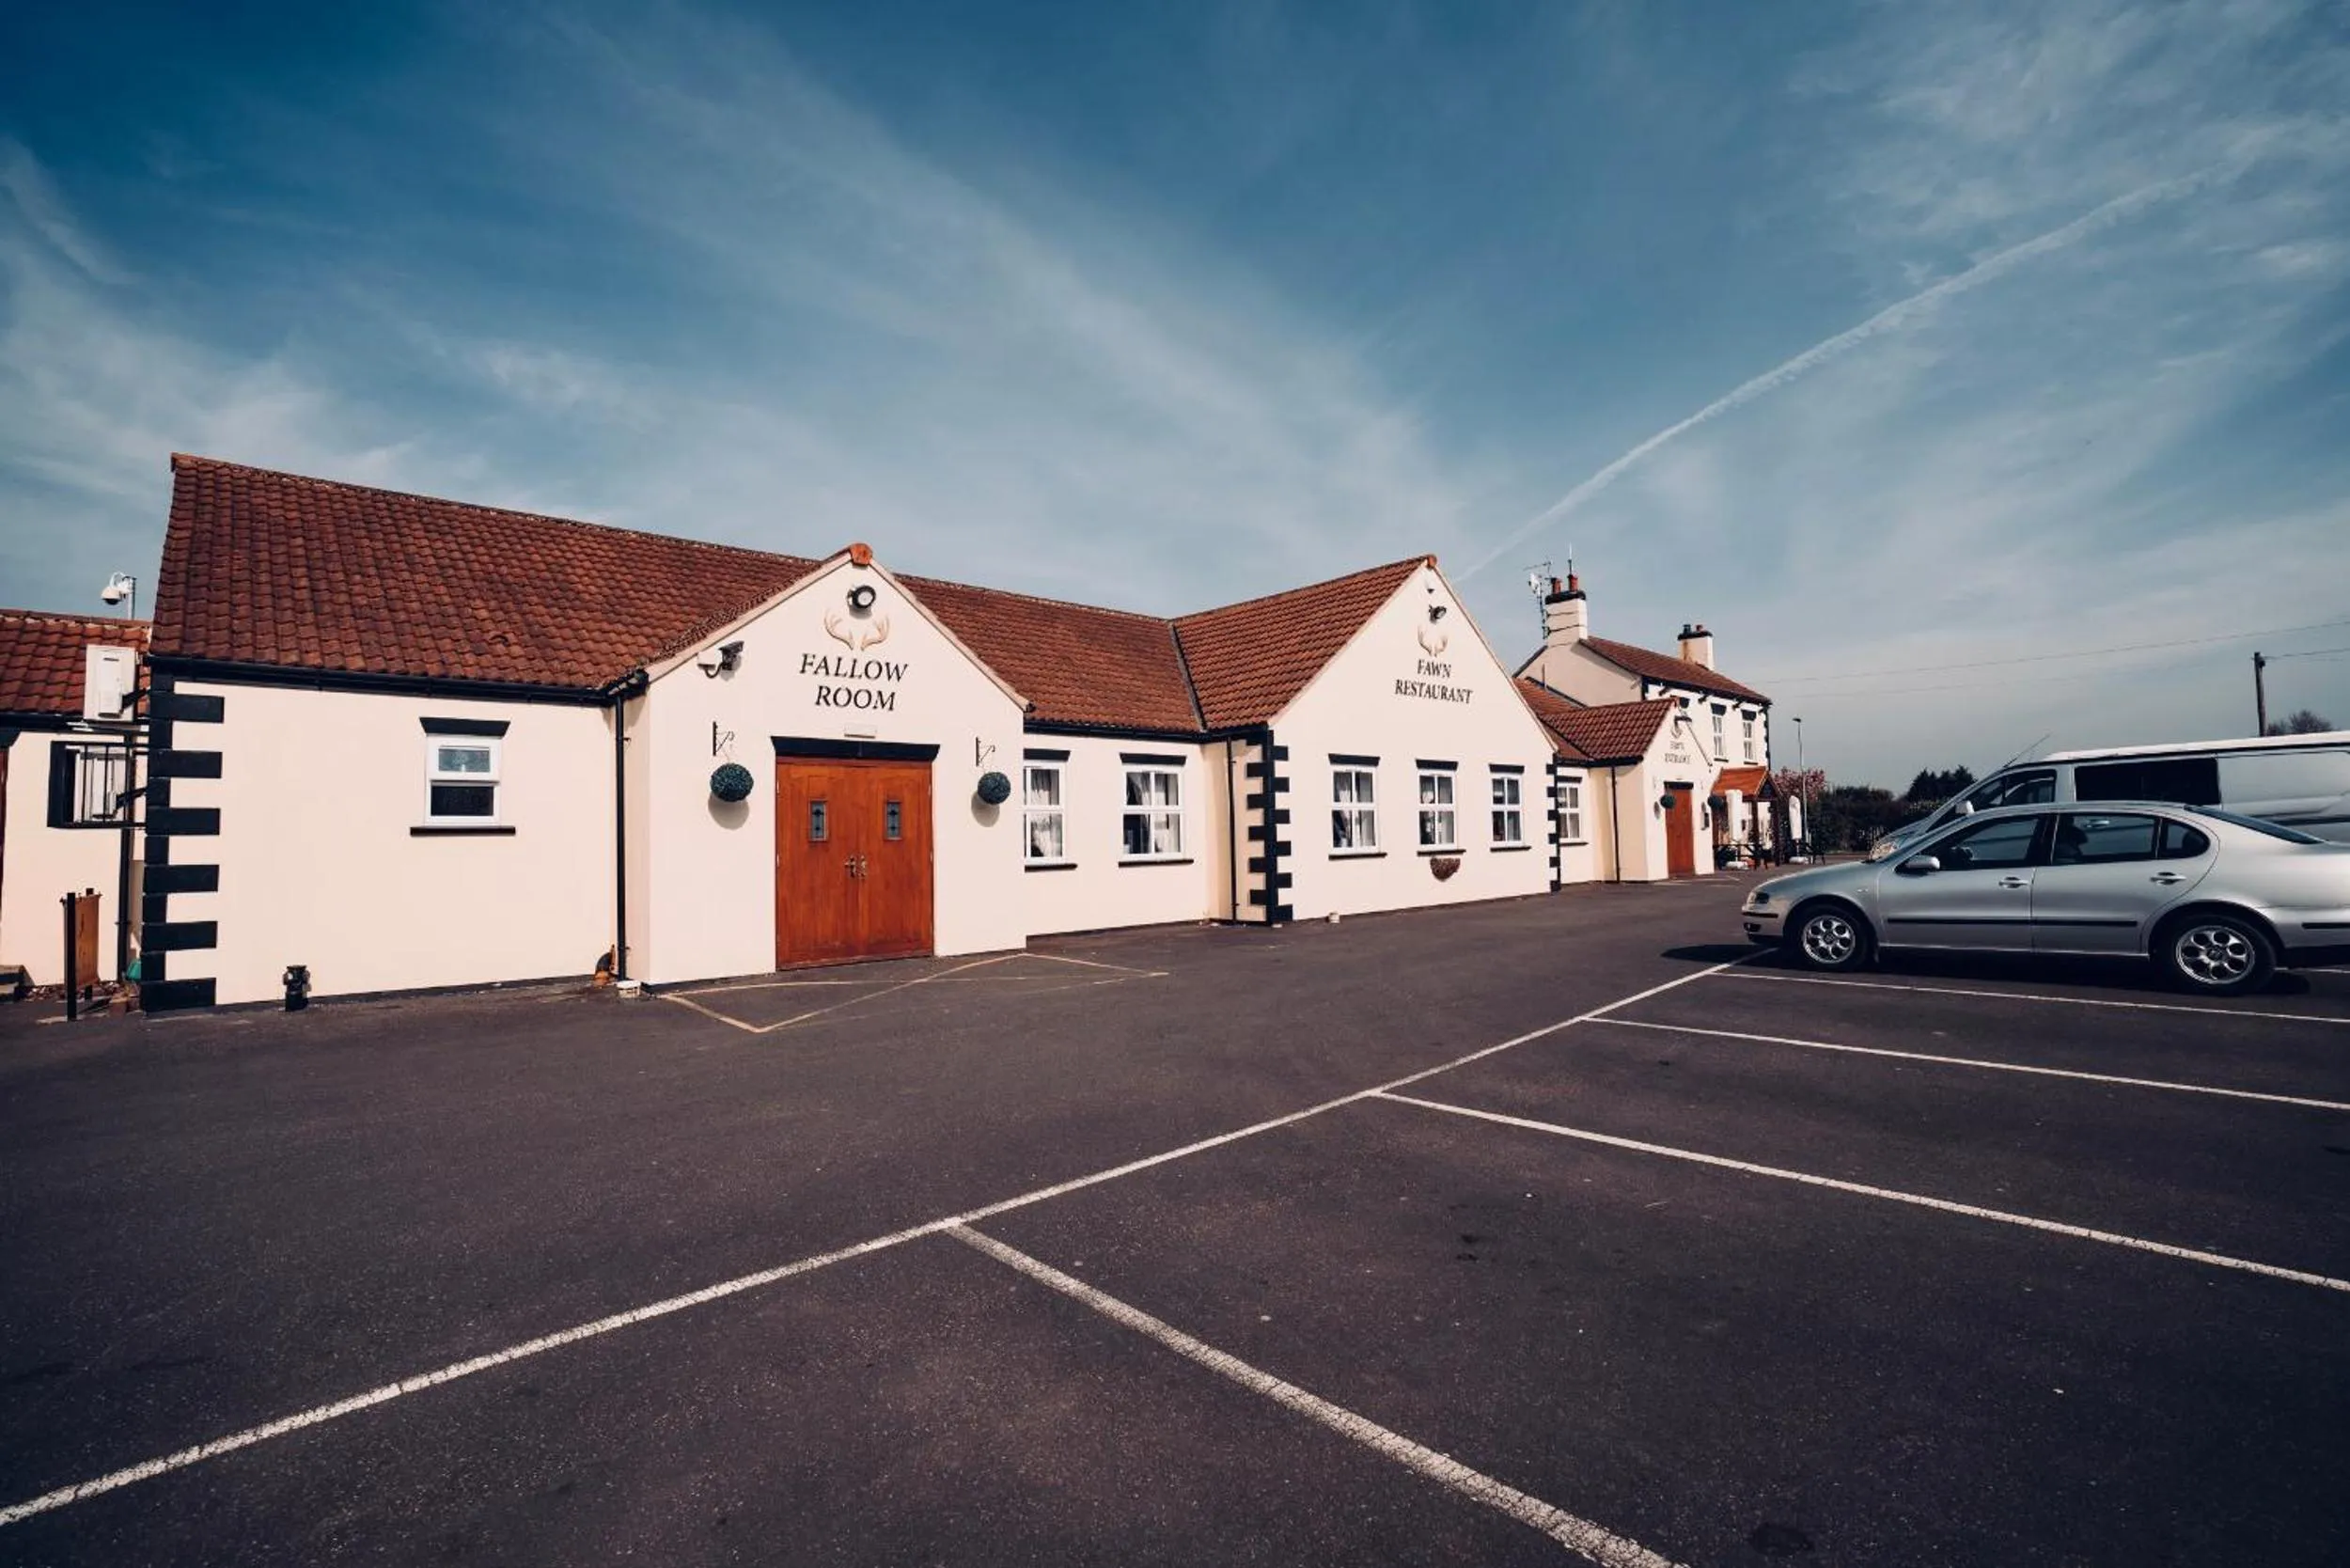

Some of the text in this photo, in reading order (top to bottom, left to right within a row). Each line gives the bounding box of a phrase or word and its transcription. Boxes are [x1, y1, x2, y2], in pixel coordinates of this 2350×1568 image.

[799, 652, 909, 682] FALLOW
[1417, 659, 1451, 678] FAWN
[815, 684, 896, 712] ROOM
[1395, 679, 1473, 704] RESTAURANT
